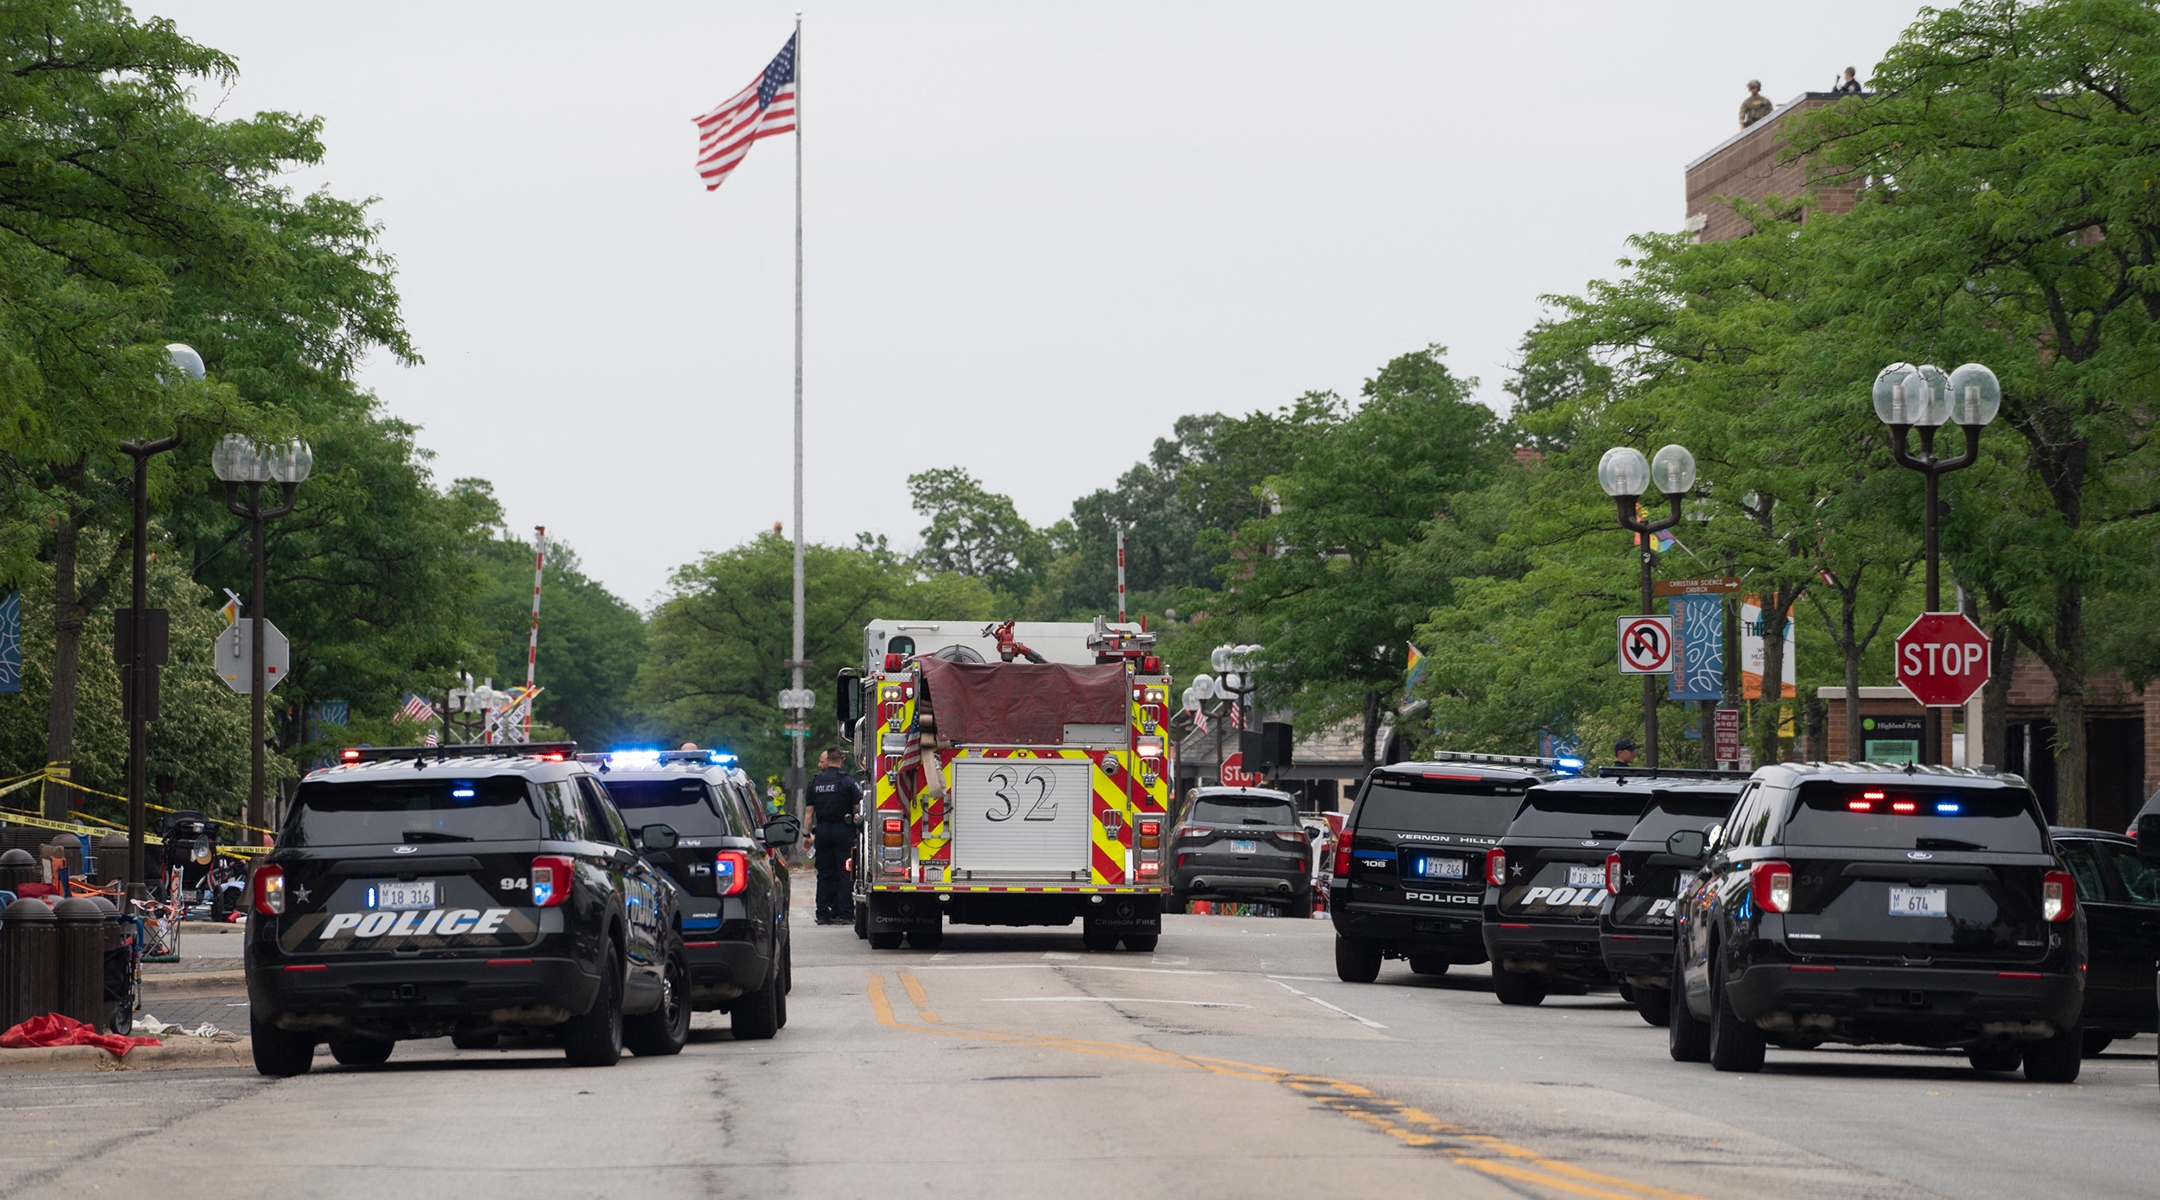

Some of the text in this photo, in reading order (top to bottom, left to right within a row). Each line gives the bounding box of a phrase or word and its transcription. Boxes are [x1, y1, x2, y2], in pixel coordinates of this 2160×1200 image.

[1673, 602, 1685, 693] HIGHLAND PARK
[1903, 643, 1983, 676] STOP
[1877, 722, 1906, 731] Highland
[1224, 765, 1254, 782] STO
[815, 784, 836, 793] POLICE
[985, 765, 1059, 822] 32
[24, 816, 37, 825] CRIME
[37, 819, 51, 828] SCENE
[65, 824, 79, 832] CROSS
[1397, 833, 1496, 845] VERNON HILLS
[687, 863, 711, 877] 15
[1433, 863, 1443, 874] 17
[1446, 864, 1460, 875] 246
[500, 877, 529, 890] 94
[1577, 873, 1588, 884] 18
[391, 890, 404, 905] 18
[410, 889, 430, 904] 316
[1405, 892, 1480, 905] POLICE
[1520, 886, 1607, 907] POLI
[1908, 896, 1928, 911] 674
[319, 908, 512, 940] POLICE
